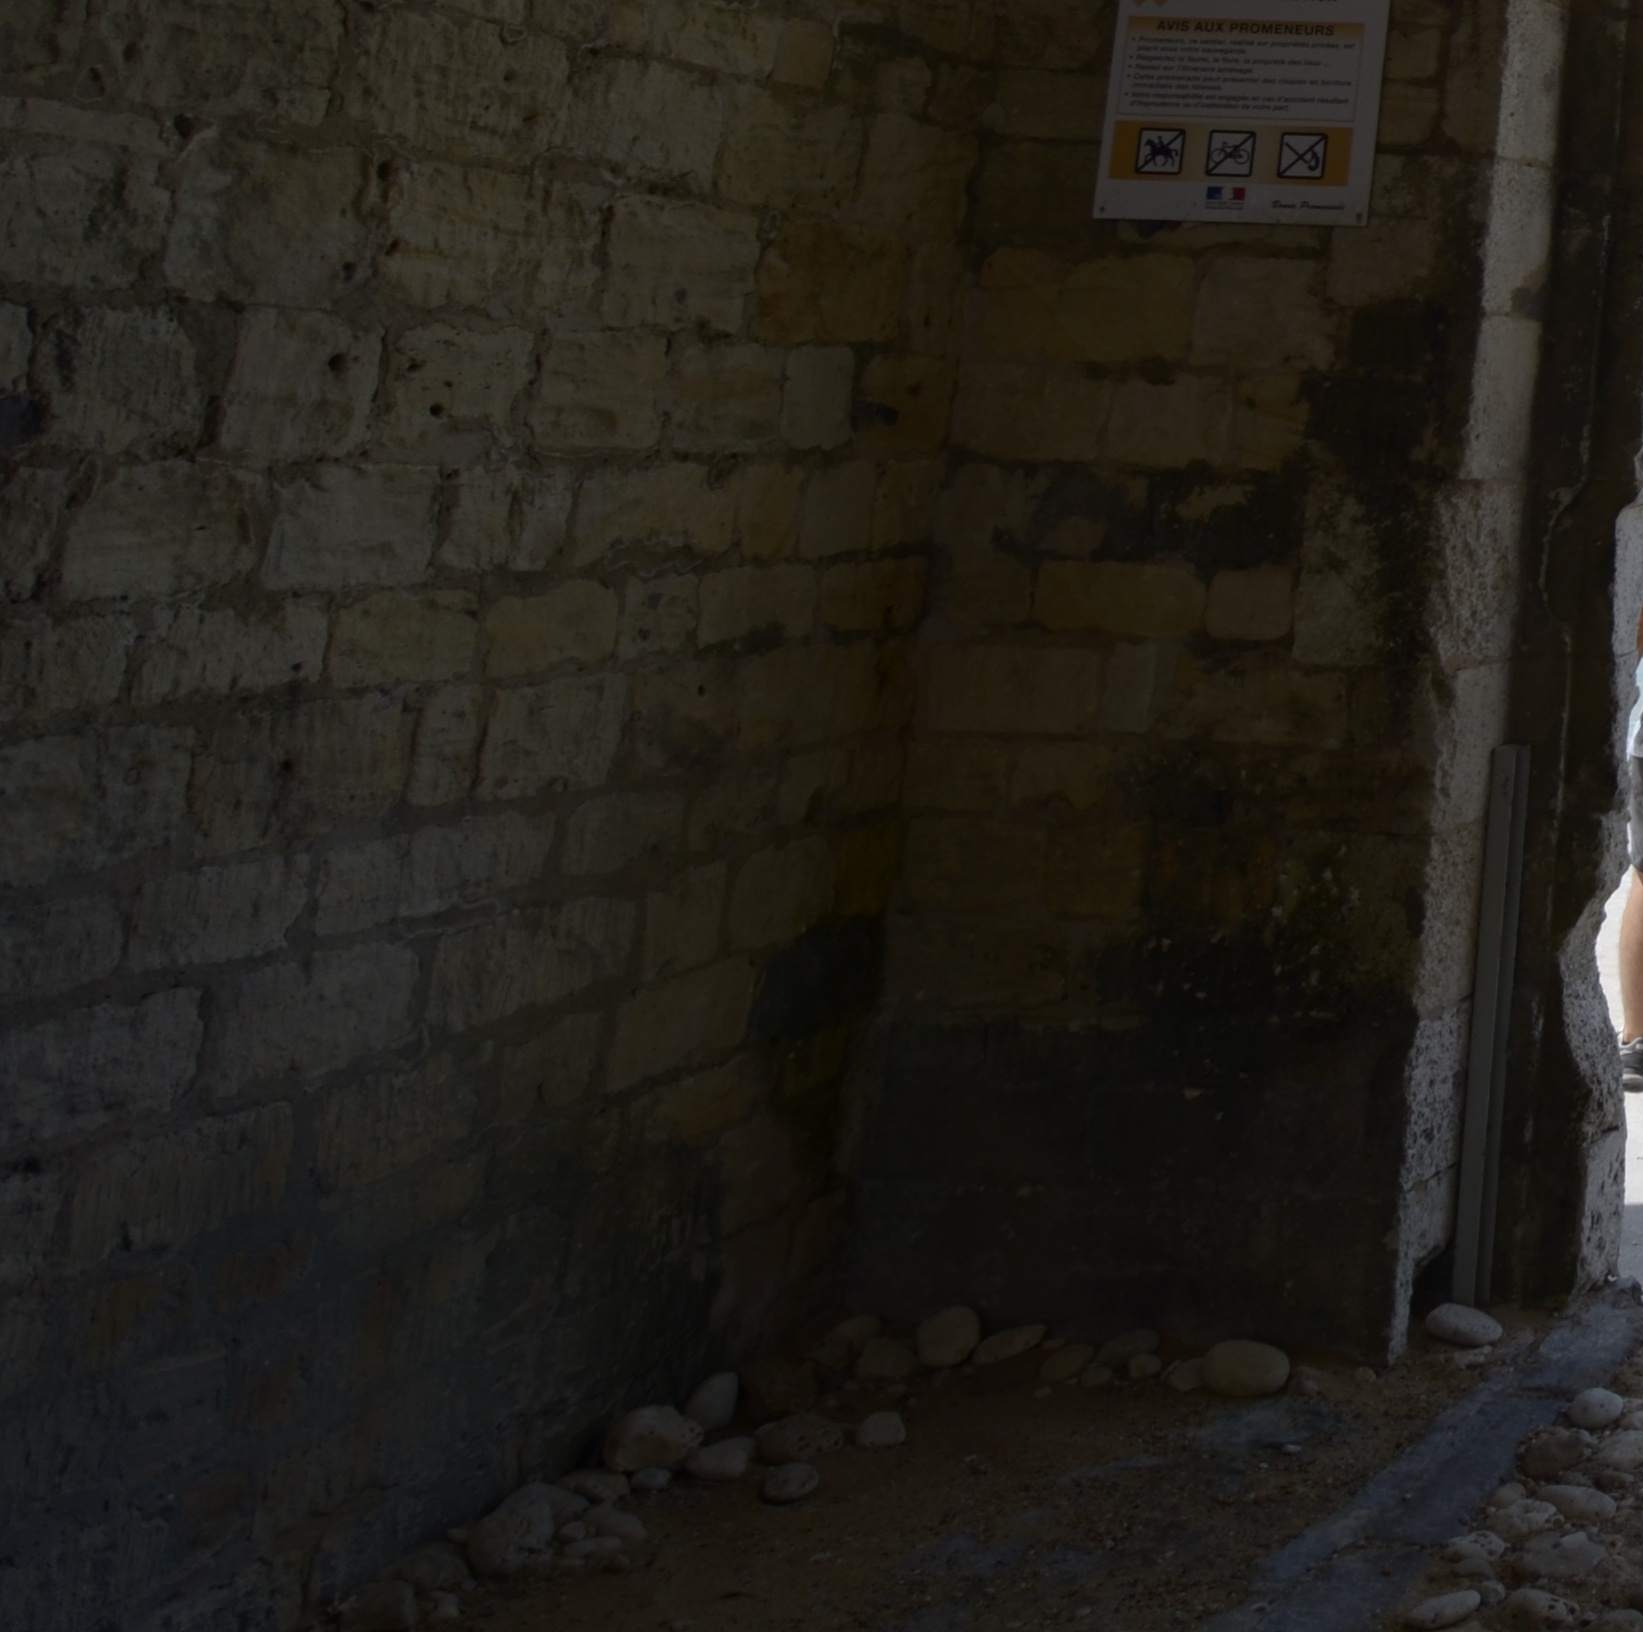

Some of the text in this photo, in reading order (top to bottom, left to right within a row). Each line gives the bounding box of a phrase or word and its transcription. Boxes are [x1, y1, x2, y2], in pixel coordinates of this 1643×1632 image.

[1156, 20, 1335, 36] AVIS AUX PROMENEURS
